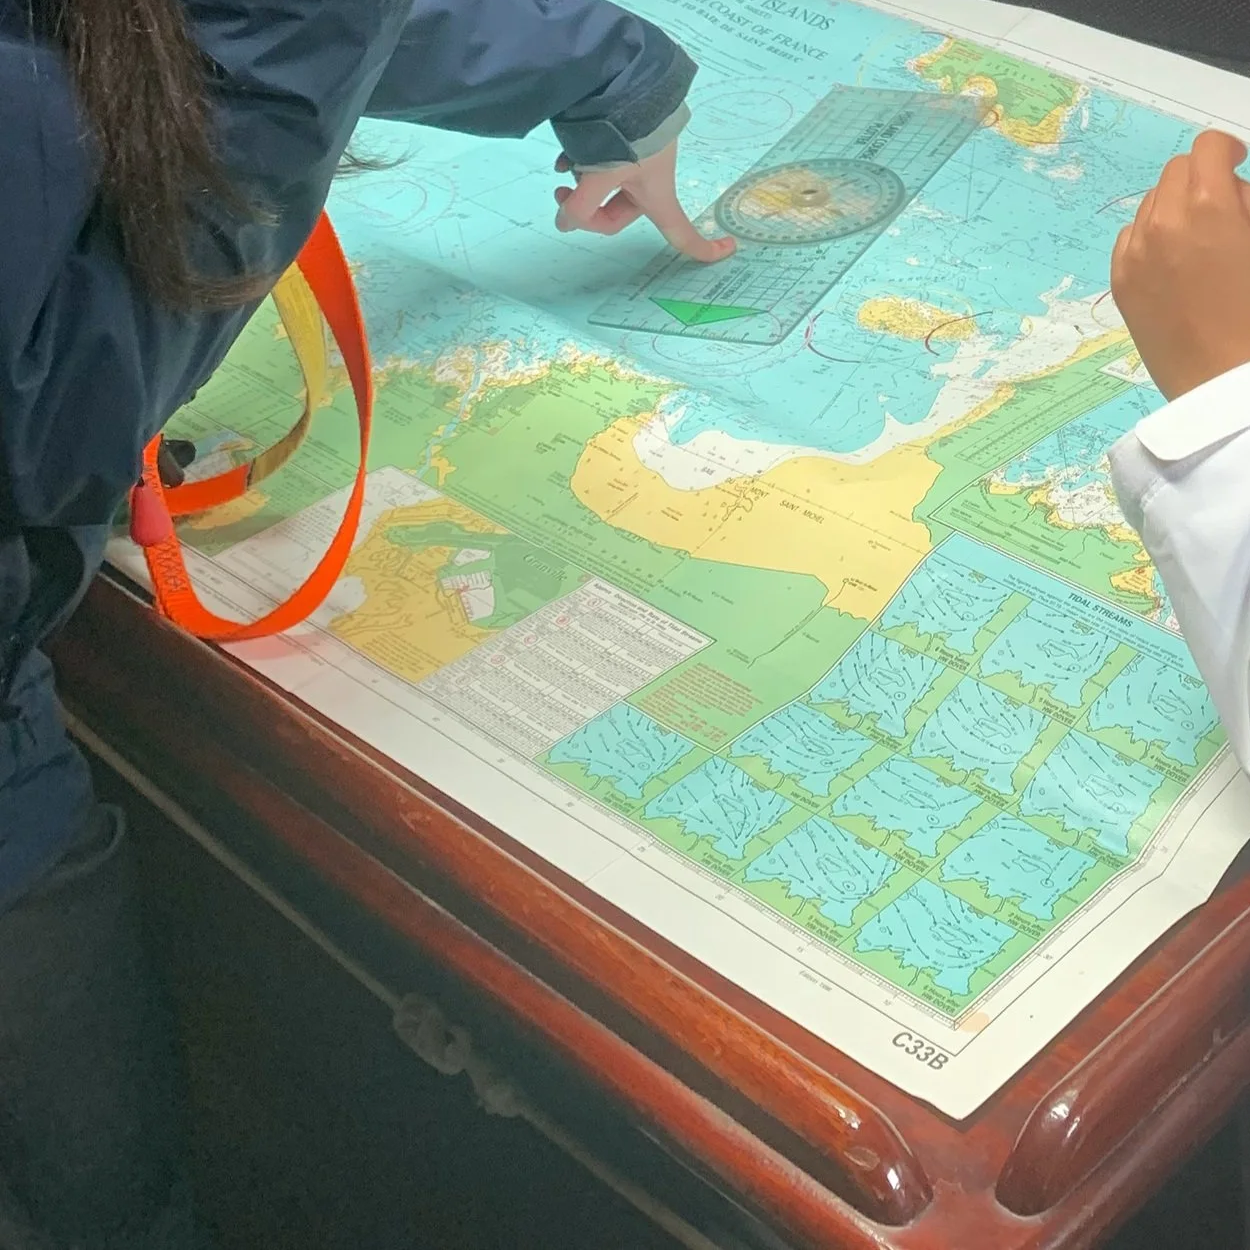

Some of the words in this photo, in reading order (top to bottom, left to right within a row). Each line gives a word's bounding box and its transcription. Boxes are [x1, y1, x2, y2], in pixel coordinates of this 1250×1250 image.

[681, 2, 696, 12] TO
[696, 8, 719, 26] BAIE
[720, 23, 733, 34] DE
[735, 32, 764, 48] SAINT
[765, 45, 804, 63] BRIEUC
[709, 0, 751, 28] COAST
[751, 23, 772, 36] OF
[772, 33, 829, 62] FRANCE
[750, 487, 770, 498] MONT
[780, 499, 800, 511] SAINT
[802, 509, 825, 524] MICHEL
[1068, 592, 1093, 610] TIDAL
[1090, 605, 1133, 628] STREAMS
[948, 660, 967, 671] DOVER
[954, 656, 970, 666] before
[1042, 706, 1052, 714] HW
[1053, 712, 1074, 724] DOVER
[1043, 700, 1058, 710] Hours
[1059, 709, 1076, 720] before
[1155, 757, 1171, 768] Hours
[1172, 766, 1190, 778] before
[1165, 769, 1187, 782] DOVER
[893, 851, 904, 860] HW
[904, 859, 925, 873] DOVER
[813, 918, 829, 930] Hours
[830, 929, 844, 938] after
[1007, 918, 1019, 926] HW
[1018, 924, 1041, 937] DOVER
[1014, 914, 1031, 926] Hours
[1031, 924, 1046, 932] after
[816, 929, 838, 942] DOVER
[921, 991, 934, 1000] HW
[933, 999, 955, 1013] DOVER
[928, 988, 946, 1000] Hours
[946, 998, 960, 1007] after
[891, 1031, 950, 1071] C33B
